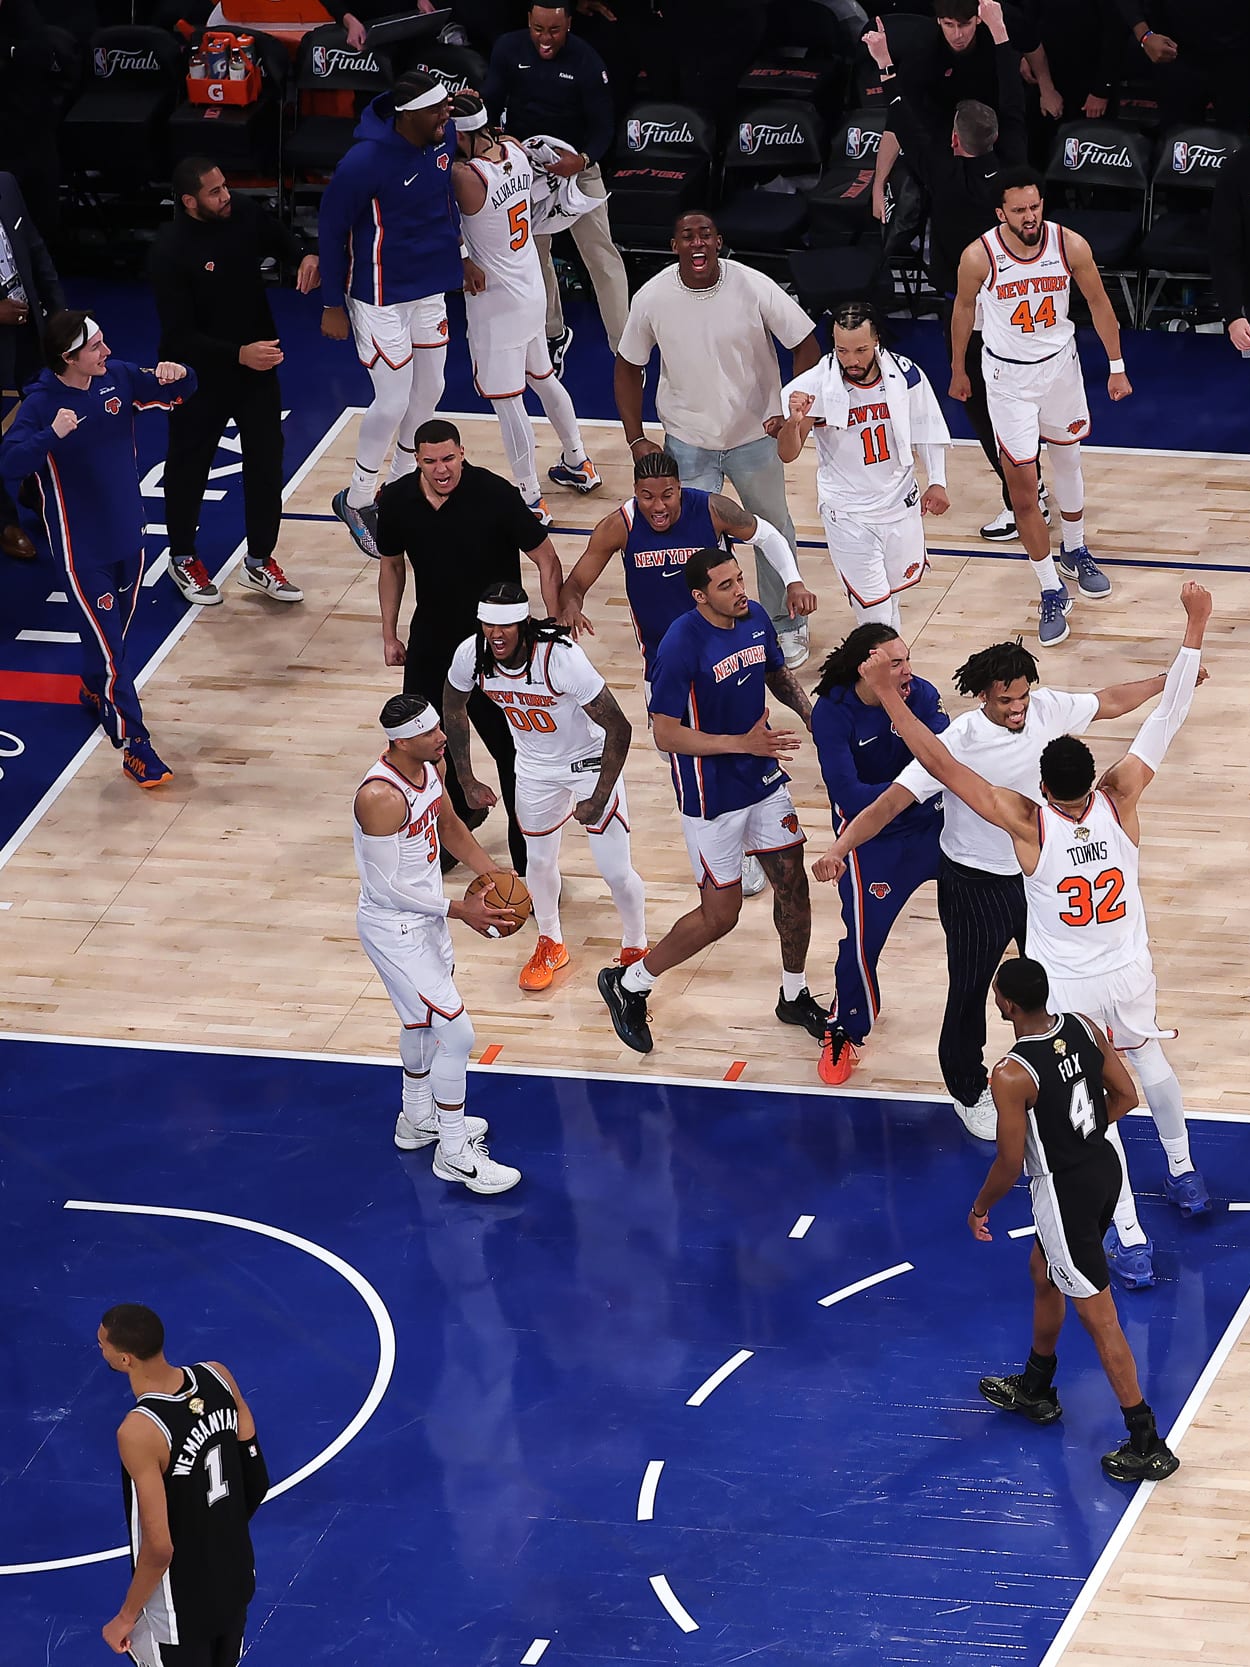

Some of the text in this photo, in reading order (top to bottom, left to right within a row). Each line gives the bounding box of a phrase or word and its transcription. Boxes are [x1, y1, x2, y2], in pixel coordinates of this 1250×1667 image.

[102, 49, 161, 78] Finals
[319, 49, 380, 78] Finals
[750, 69, 821, 79] NEW YORK
[207, 84, 224, 101] G
[635, 121, 694, 152] Finals
[747, 123, 804, 155] Finals
[1069, 141, 1133, 171] Finals
[614, 168, 688, 180] NEW YORK
[507, 199, 529, 251] 5
[996, 275, 1068, 300] NEW YORK
[1010, 296, 1057, 333] 44
[861, 423, 890, 466] 11
[634, 551, 666, 569] NEW
[713, 645, 767, 684] NEW YORK
[503, 706, 558, 733] 00
[406, 809, 429, 839] NEW
[425, 823, 438, 864] 3
[1066, 841, 1108, 867] TOWNS
[1057, 867, 1126, 927] 32
[1057, 1052, 1082, 1082] FOX
[1069, 1077, 1097, 1140] 4
[204, 1443, 230, 1508] 1
